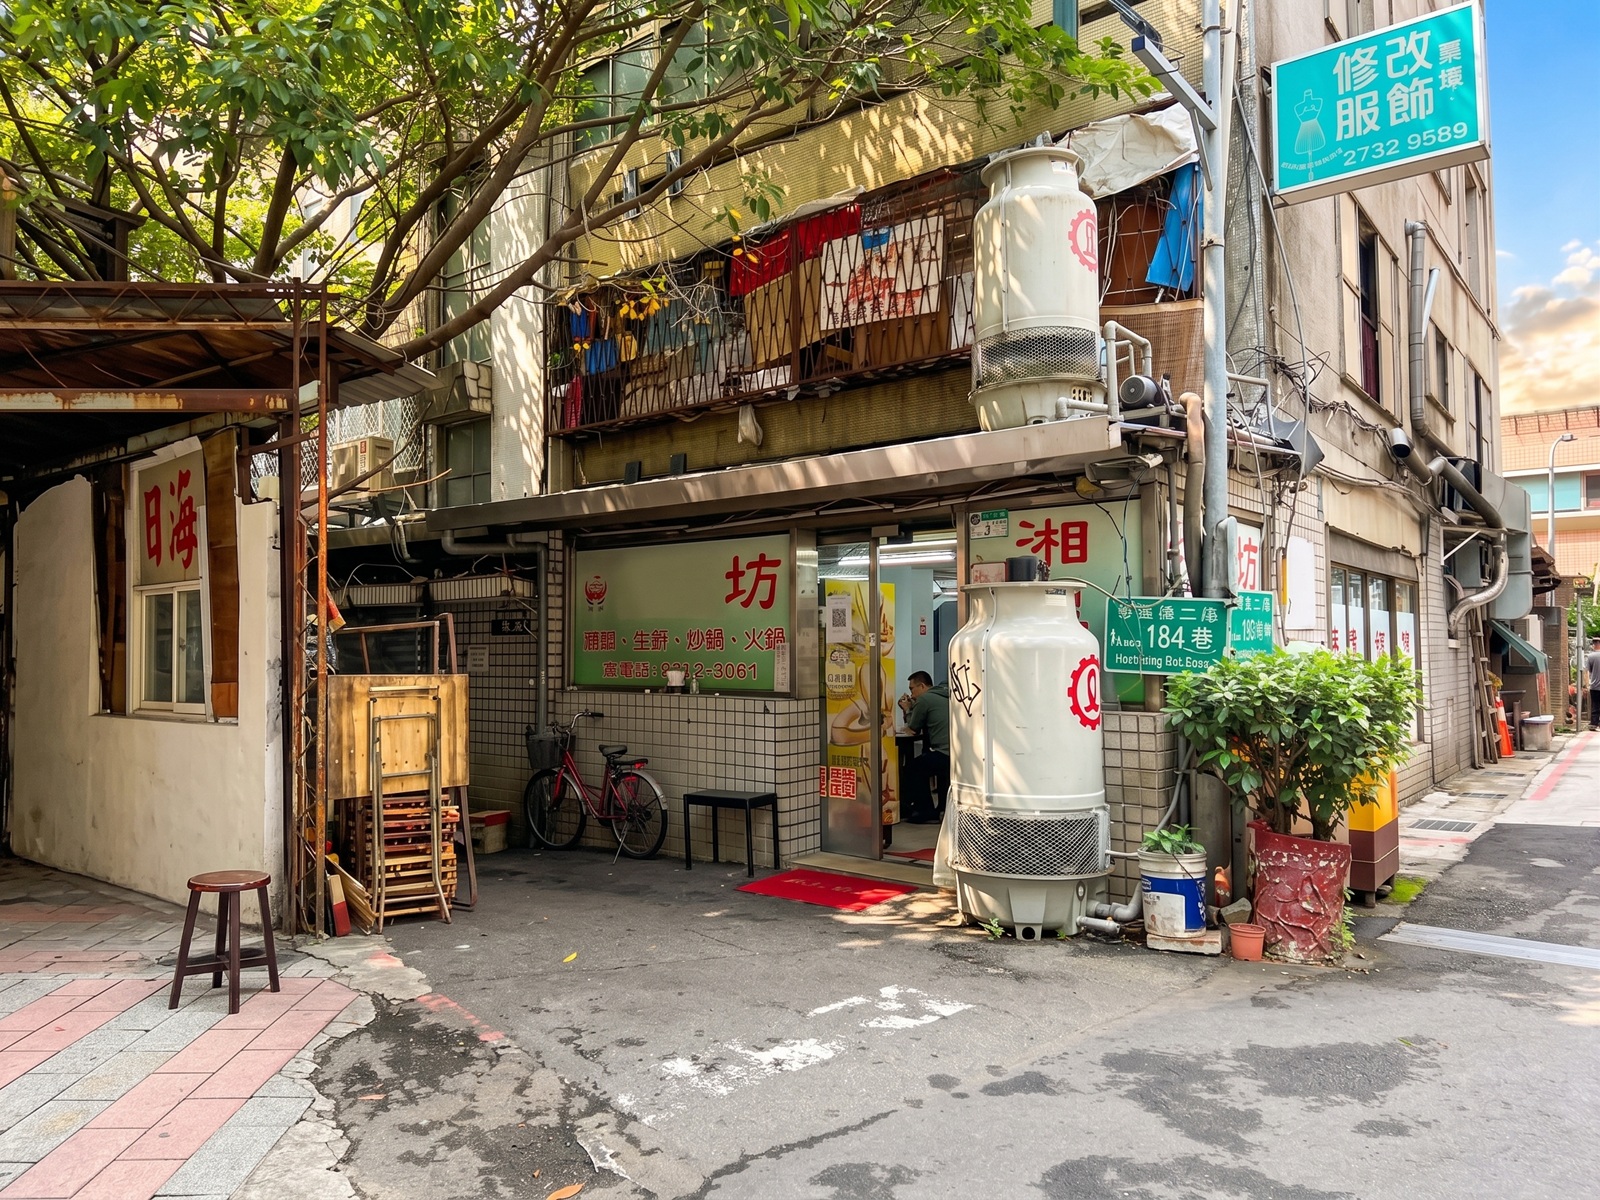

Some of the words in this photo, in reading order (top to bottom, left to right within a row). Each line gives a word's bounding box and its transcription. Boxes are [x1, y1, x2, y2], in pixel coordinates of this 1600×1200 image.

[1333, 30, 1433, 95] 修改
[1335, 77, 1434, 141] 服飾
[1343, 139, 1399, 167] 2732
[1407, 122, 1468, 150] 9589
[1016, 518, 1088, 567] 湘
[724, 553, 782, 610] 坊
[1147, 624, 1185, 649] 184
[1191, 627, 1213, 650] 巷
